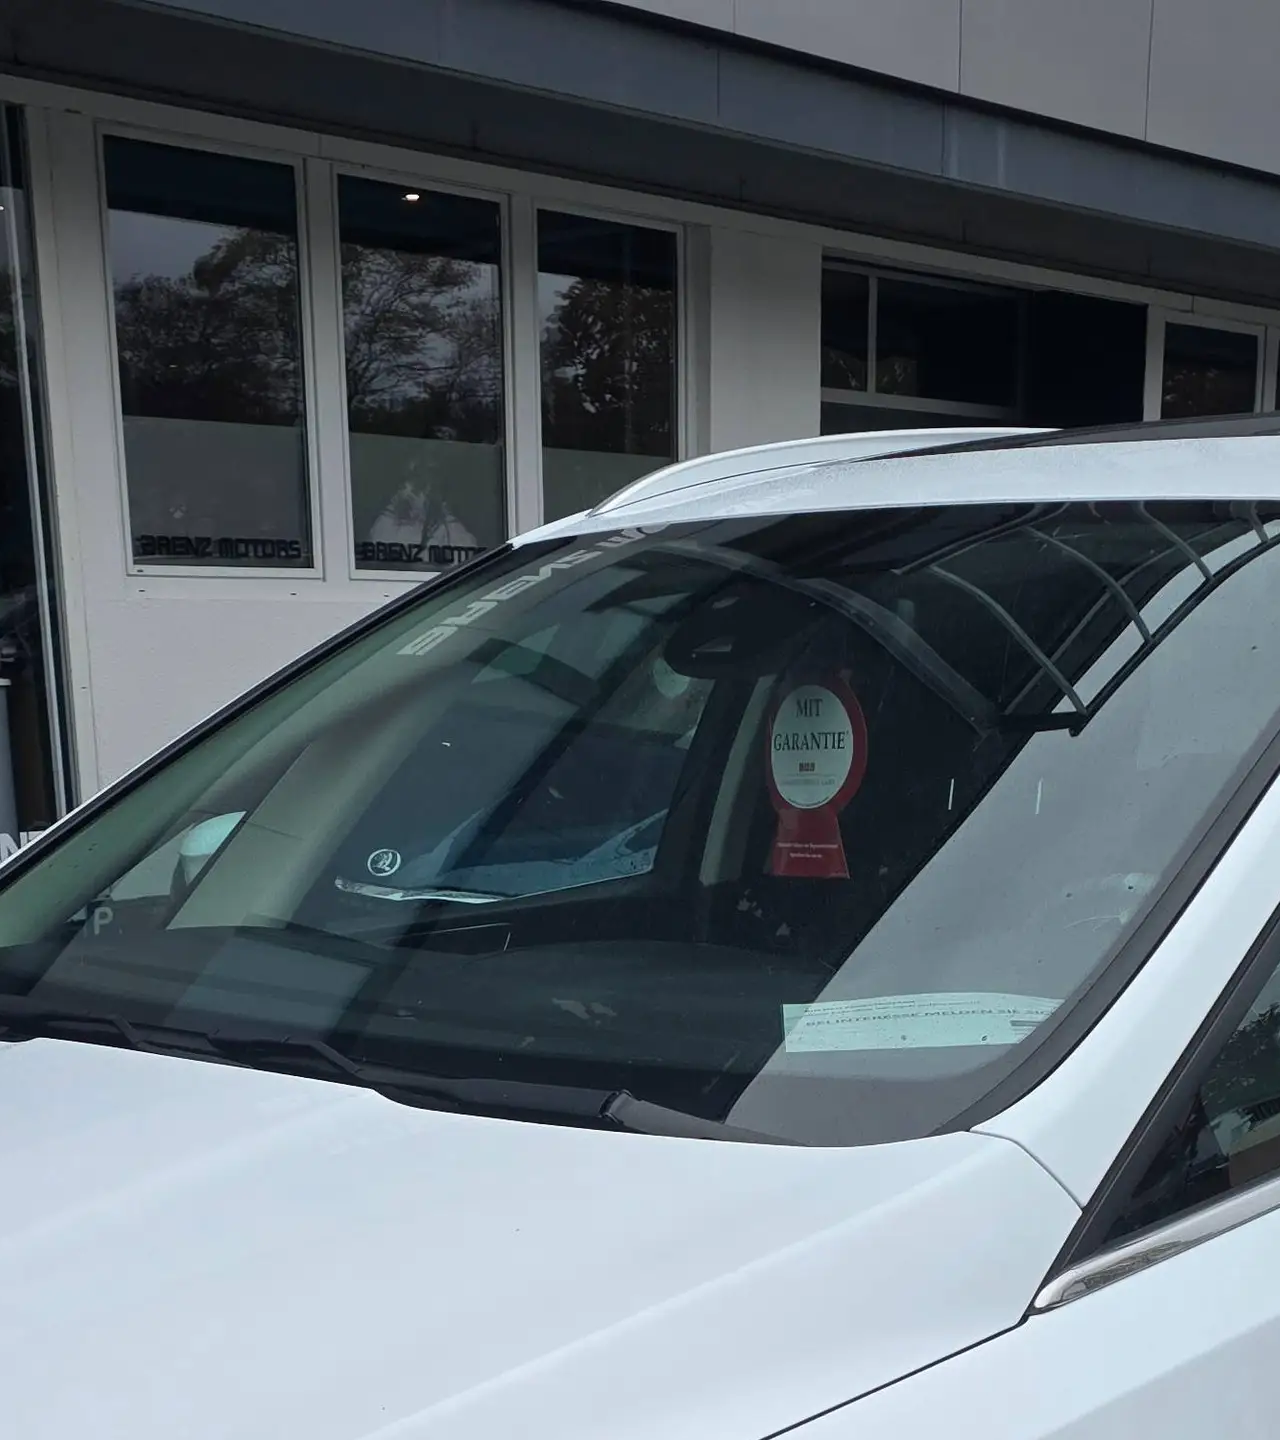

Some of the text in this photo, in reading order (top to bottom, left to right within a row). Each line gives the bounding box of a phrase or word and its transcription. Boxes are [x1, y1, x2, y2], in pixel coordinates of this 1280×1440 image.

[140, 535, 301, 559] BRENZ MOTORS
[795, 697, 823, 718] MIT
[773, 731, 847, 752] GARANTIE
